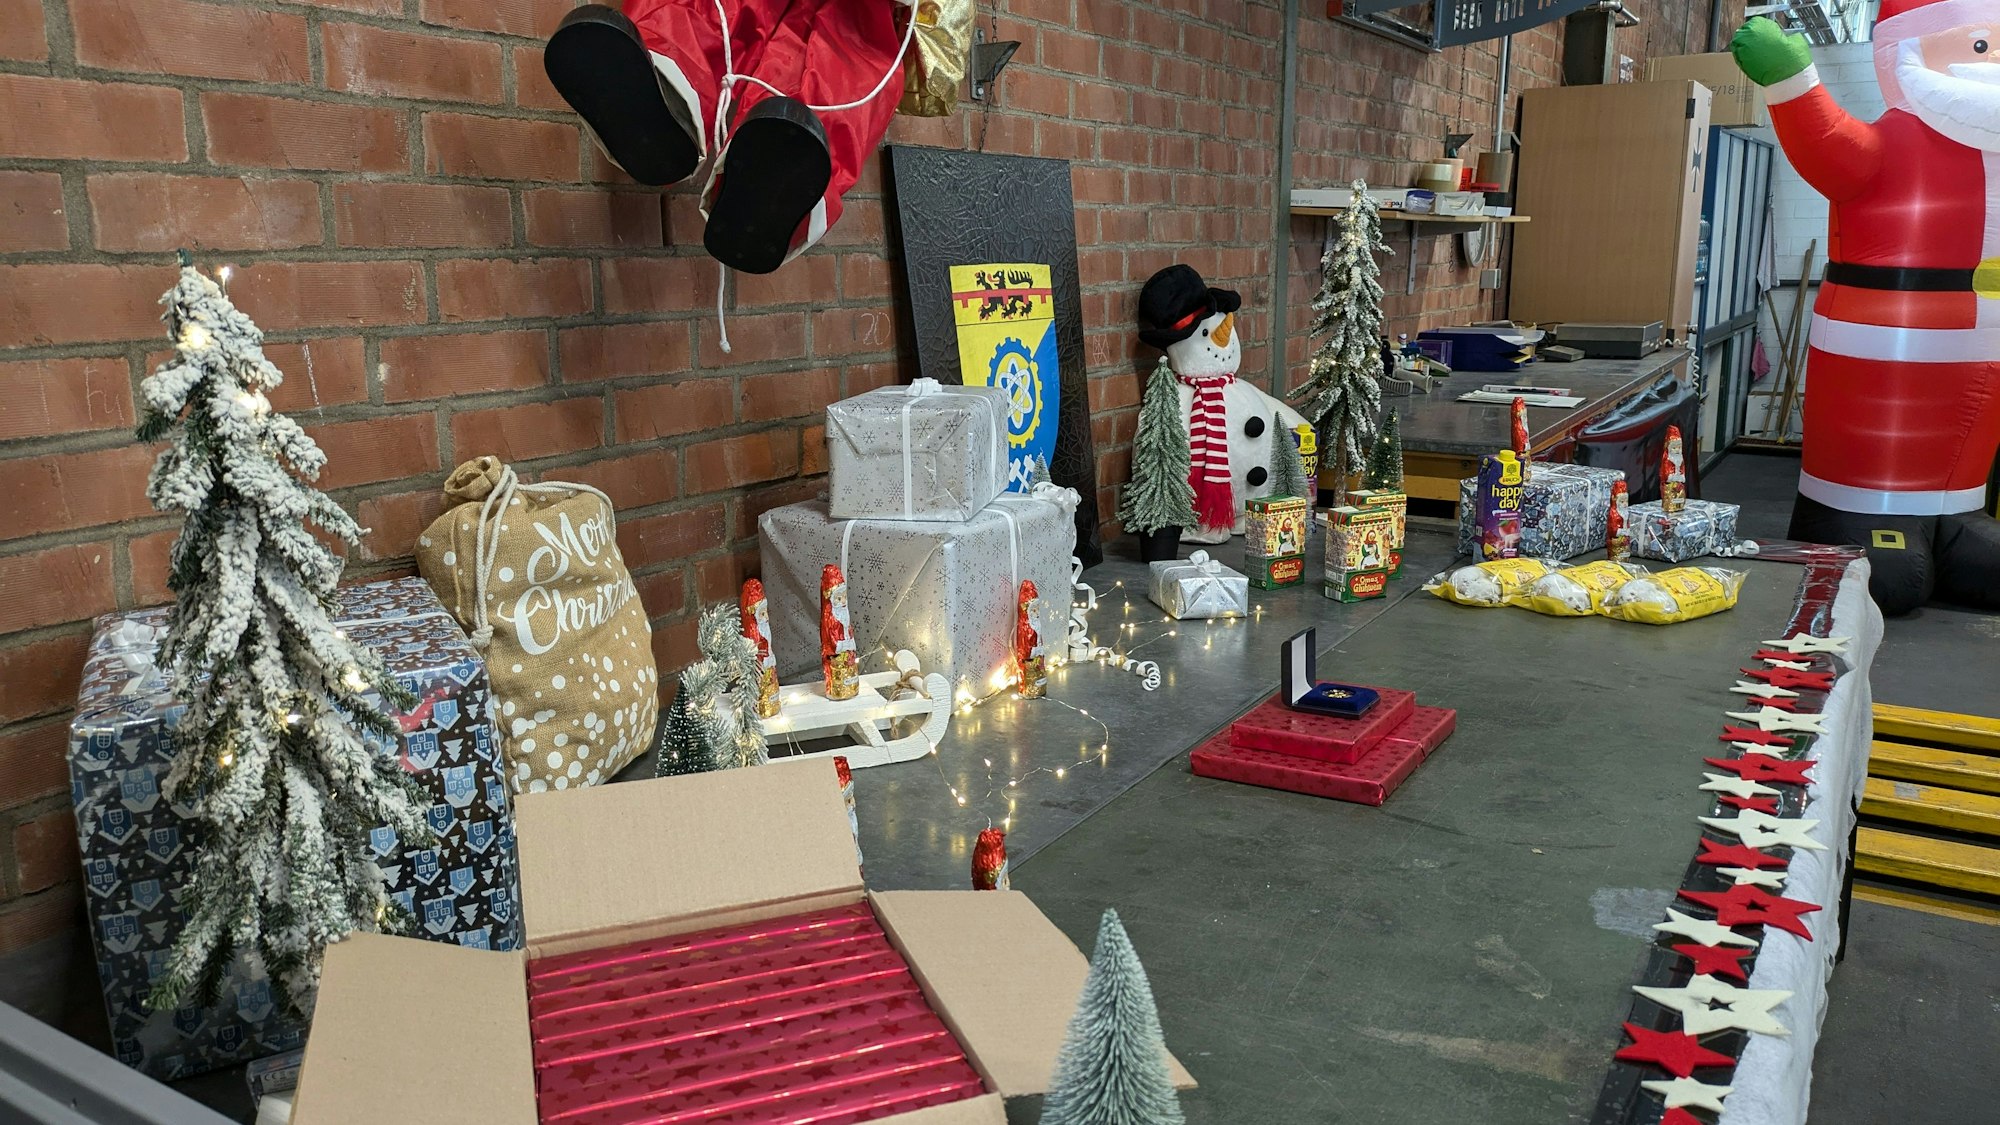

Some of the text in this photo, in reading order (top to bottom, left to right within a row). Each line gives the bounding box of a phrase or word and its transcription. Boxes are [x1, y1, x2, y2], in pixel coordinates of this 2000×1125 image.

[1299, 456, 1319, 468] appy
[1499, 497, 1520, 511] day
[1360, 576, 1379, 584] Omas
